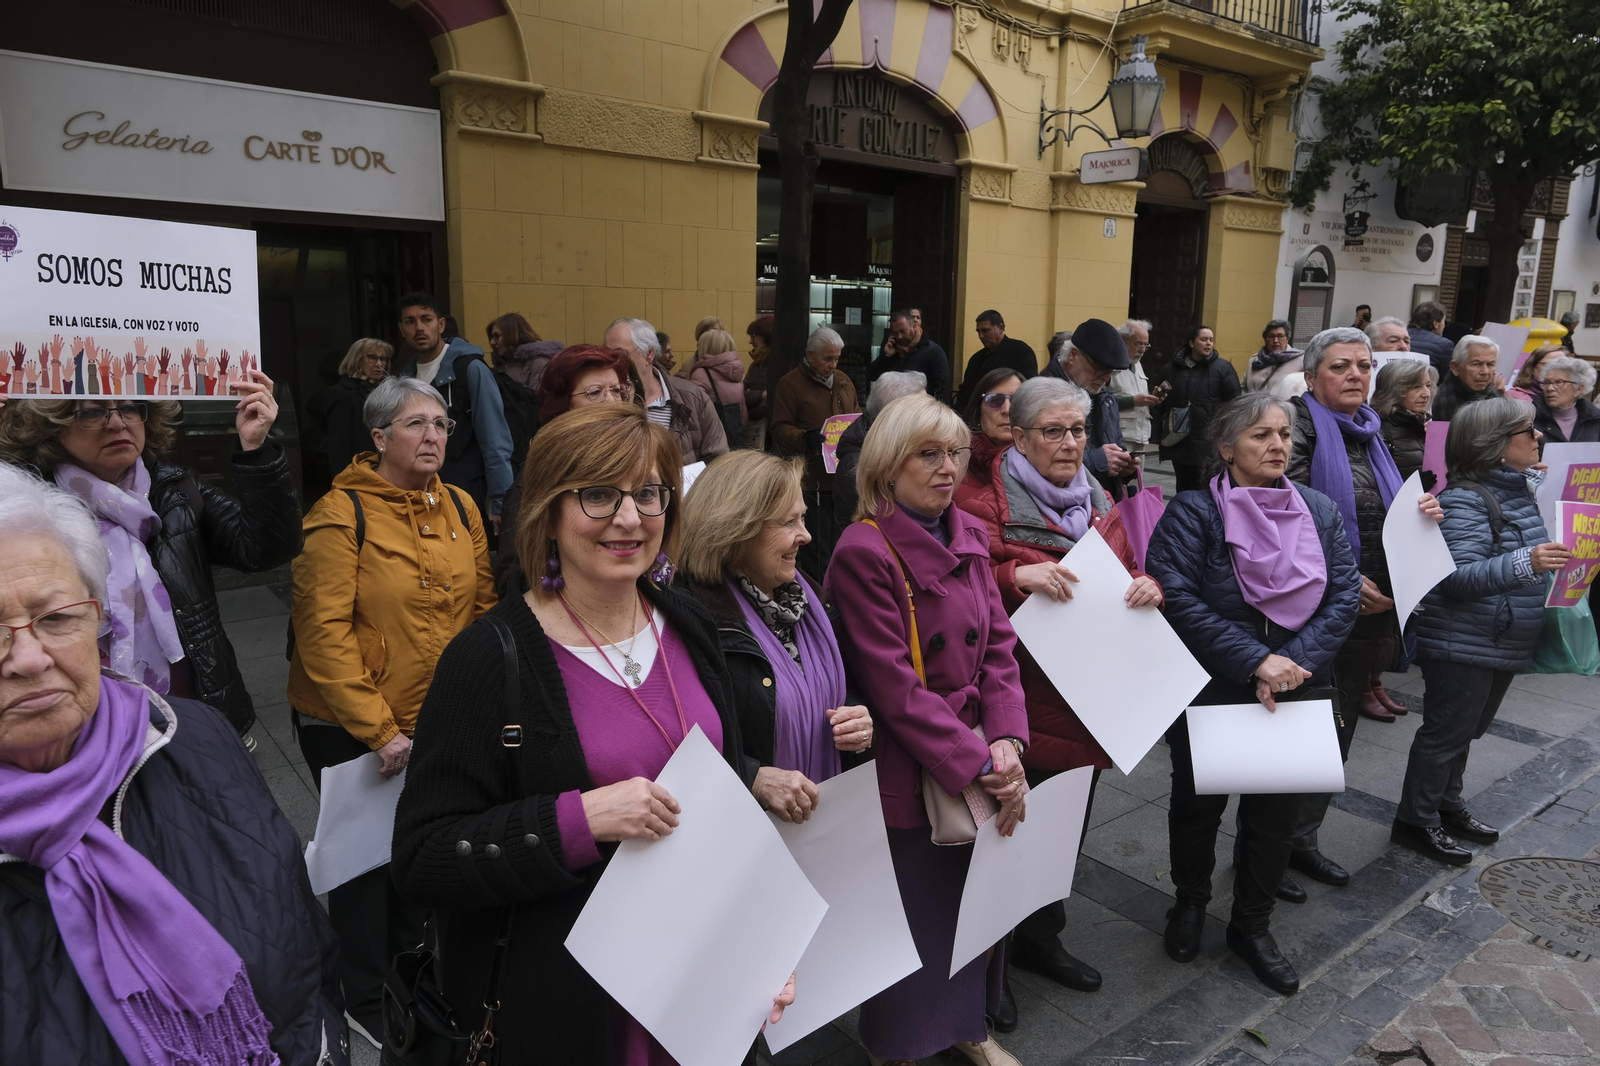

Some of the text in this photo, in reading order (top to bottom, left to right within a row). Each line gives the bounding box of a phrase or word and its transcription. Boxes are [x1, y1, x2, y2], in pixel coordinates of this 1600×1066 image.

[834, 74, 899, 116] ANTONIO
[62, 110, 214, 155] Gelateria
[244, 134, 321, 163] CARTE
[1089, 158, 1131, 170] MAJORICA
[1369, 224, 1414, 236] ASTRONÓMICAS
[37, 252, 232, 295] SOMOS MUCHAS
[868, 265, 892, 275] MAJORI
[49, 314, 200, 333] EN LA IGLESIA, CON VOZ Y VOTO
